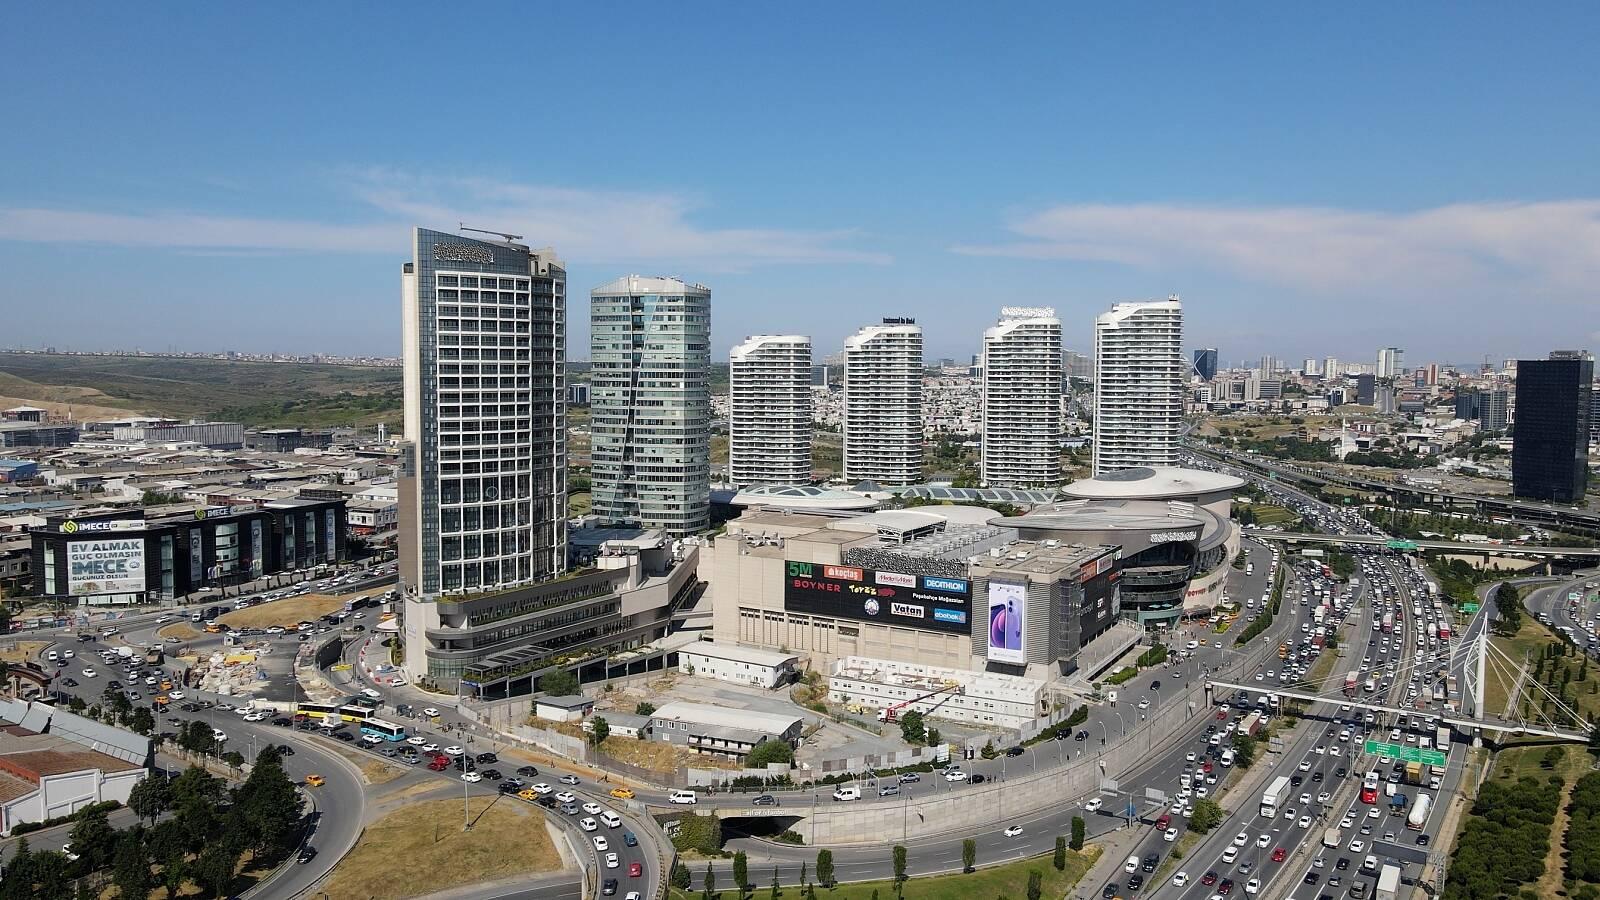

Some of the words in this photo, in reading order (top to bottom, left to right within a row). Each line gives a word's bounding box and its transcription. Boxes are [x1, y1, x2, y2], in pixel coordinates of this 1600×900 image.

[71, 544, 88, 553] EV
[92, 541, 140, 552] ALMAK
[95, 551, 142, 559] OLMASIN
[789, 561, 812, 577] 5M
[794, 579, 841, 593] BOYNER
[926, 580, 964, 590] DECATHLON
[894, 604, 922, 615] Vatan
